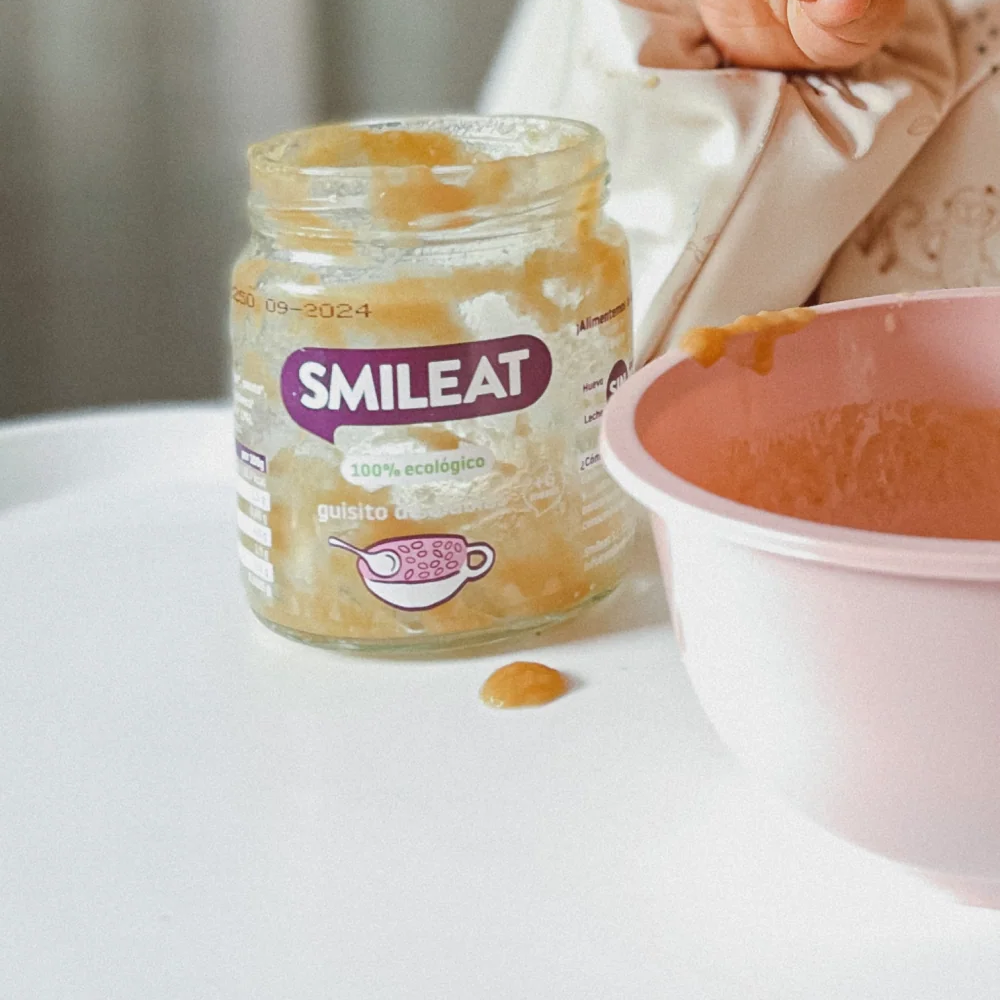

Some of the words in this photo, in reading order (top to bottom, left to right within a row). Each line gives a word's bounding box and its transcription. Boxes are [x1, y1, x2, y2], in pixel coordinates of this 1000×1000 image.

[265, 298, 373, 318] 09-2024
[299, 349, 530, 411] SMILEAT
[351, 462, 400, 477] 100%
[404, 456, 485, 476] ecológico
[317, 502, 388, 522] guisito
